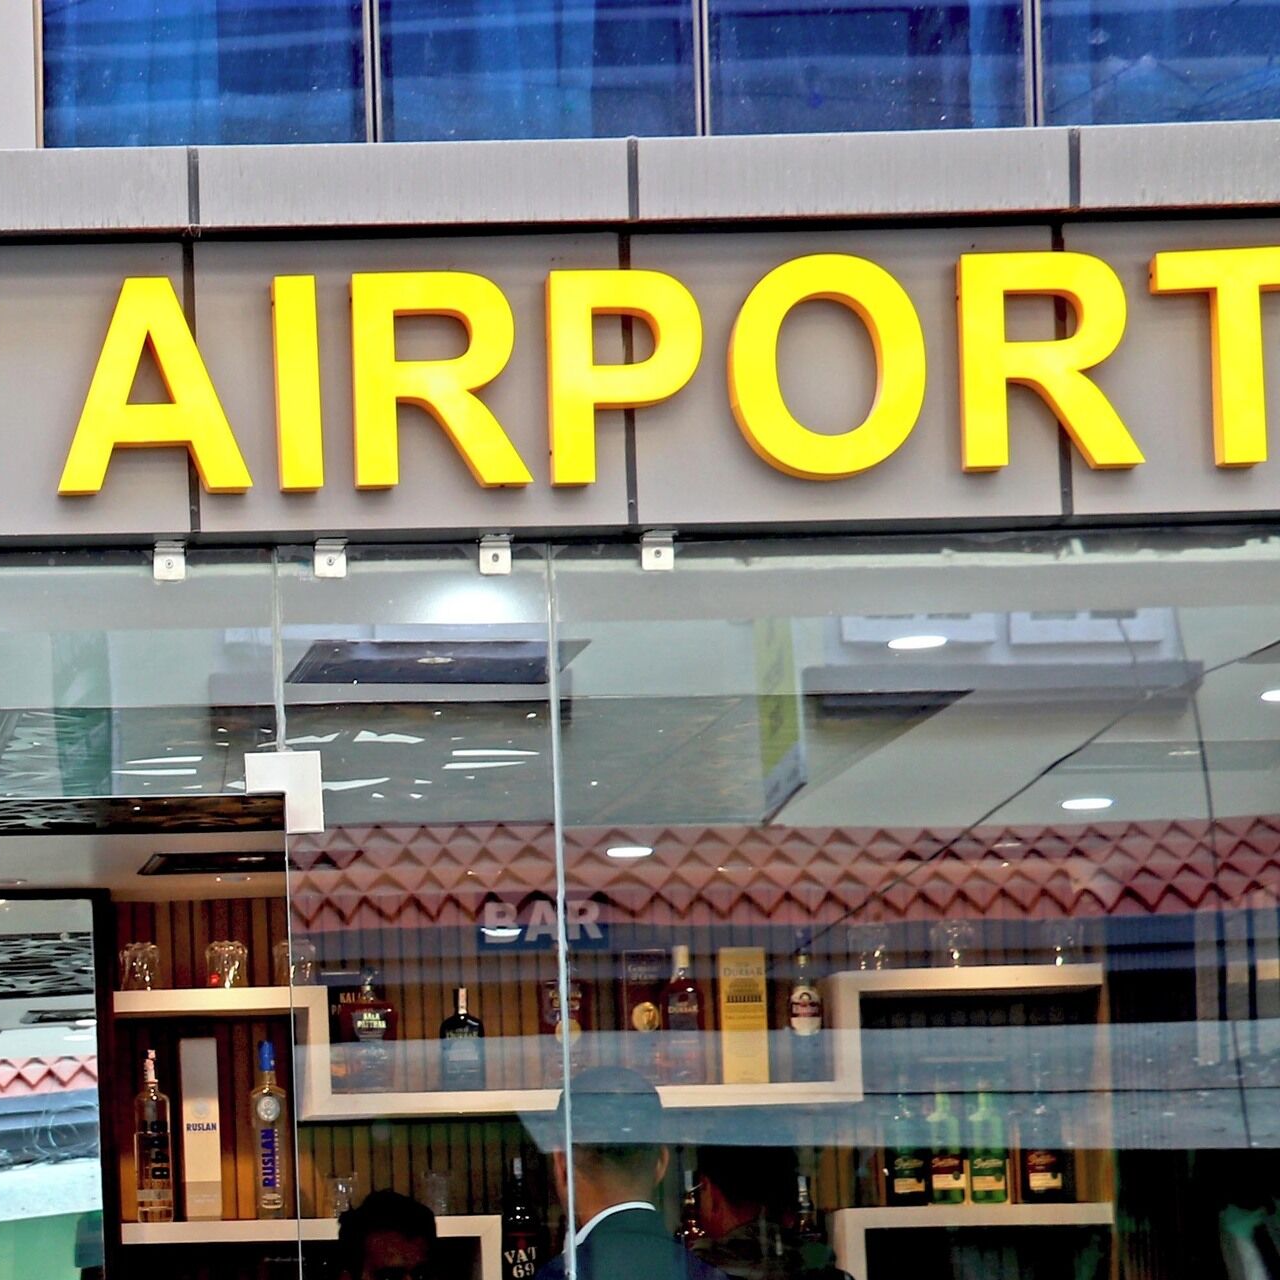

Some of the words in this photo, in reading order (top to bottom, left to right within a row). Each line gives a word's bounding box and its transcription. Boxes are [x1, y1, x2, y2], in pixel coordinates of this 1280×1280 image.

[57, 247, 1280, 496] AIRPORT
[485, 899, 603, 943] BAR
[186, 1123, 217, 1132] RUSLAN
[260, 1128, 276, 1188] RUSLAN
[504, 1246, 537, 1264] VAT
[512, 1262, 535, 1278] 69
